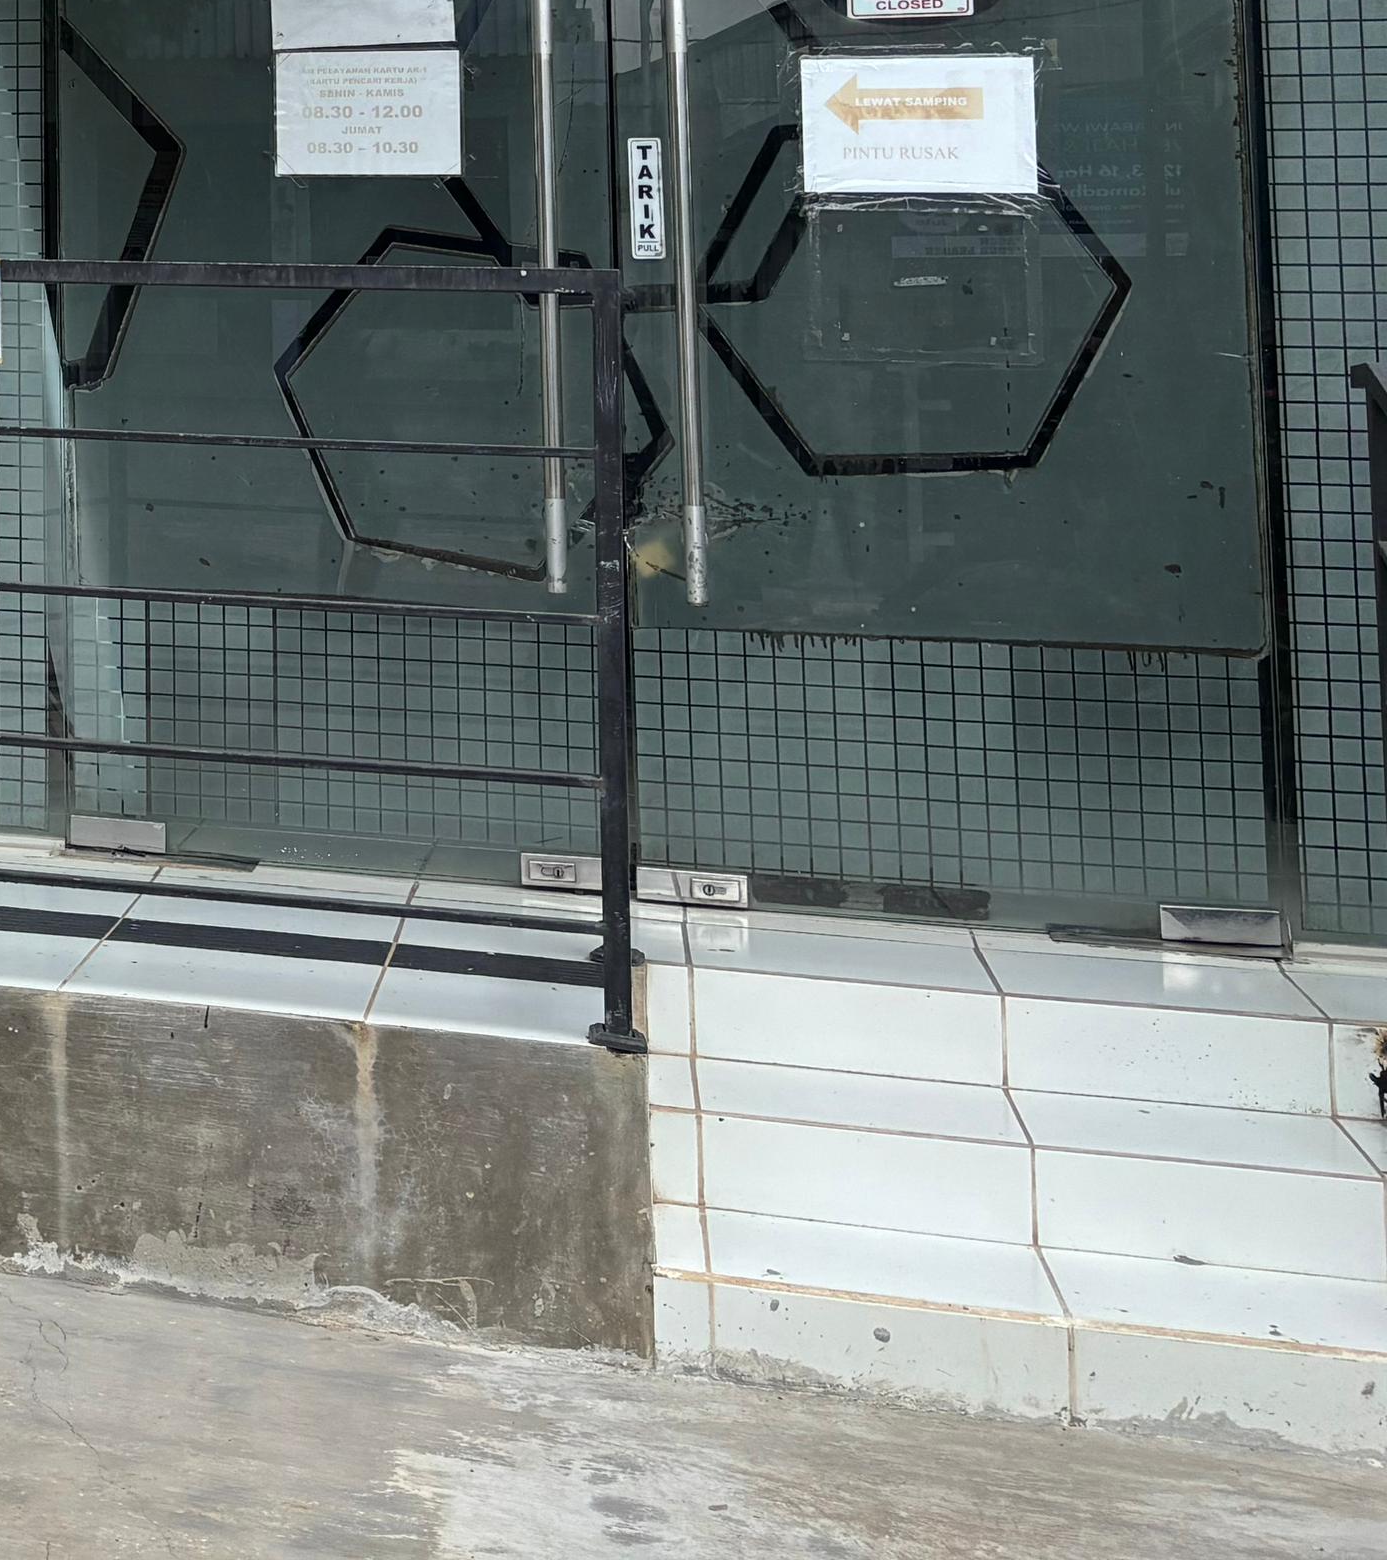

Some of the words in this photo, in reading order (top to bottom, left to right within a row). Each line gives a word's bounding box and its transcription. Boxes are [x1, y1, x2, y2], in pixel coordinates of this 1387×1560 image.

[875, 0, 944, 11] CLOSED
[319, 89, 355, 98] SENIN
[366, 88, 405, 98] KAMIS
[855, 97, 901, 107] LEWAT
[905, 96, 968, 107] SAMPING
[302, 106, 353, 119] 08.30
[371, 105, 423, 118] 12.00
[342, 126, 382, 135] JUMAT
[307, 142, 353, 154] 08.30
[372, 141, 418, 154] 10.30
[843, 146, 893, 159] PINTU
[900, 146, 959, 159] RUSAK
[636, 145, 656, 239] TARIK
[637, 244, 659, 252] PULL
